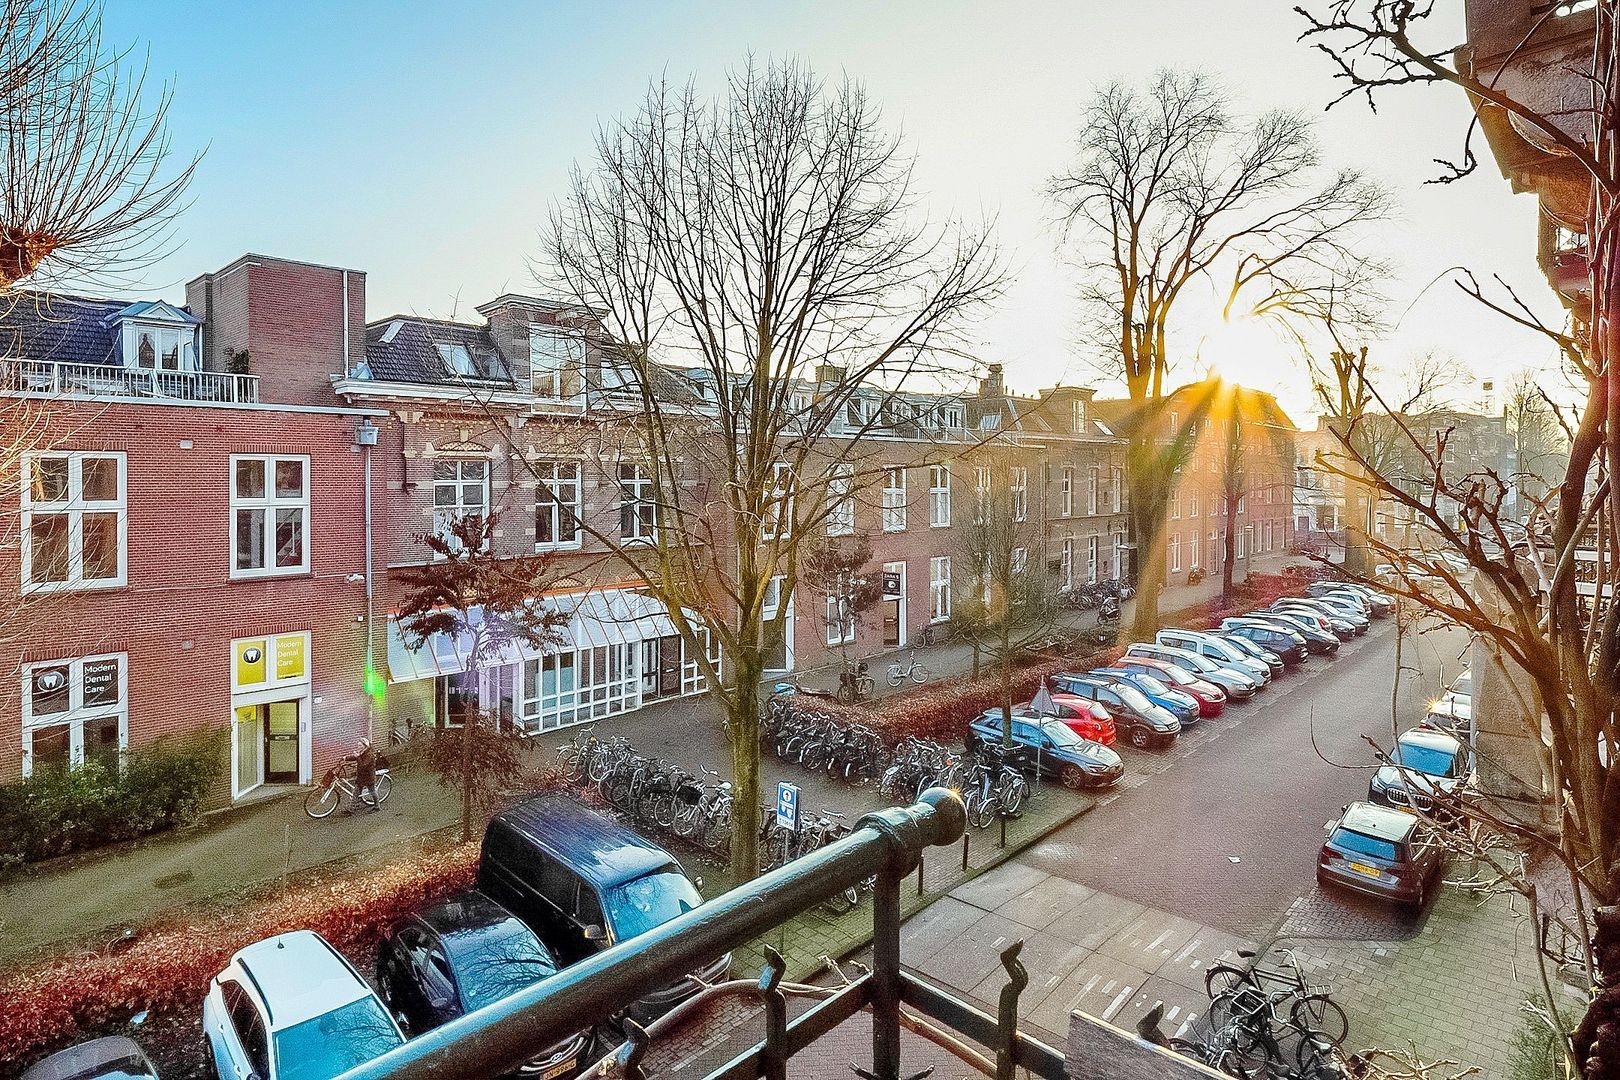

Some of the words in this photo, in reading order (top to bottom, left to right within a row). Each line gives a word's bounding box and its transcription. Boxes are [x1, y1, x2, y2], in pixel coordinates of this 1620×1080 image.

[277, 649, 299, 657] Dental
[277, 659, 293, 667] Care
[84, 663, 117, 674] Modern
[84, 673, 112, 684] Dental
[84, 685, 105, 694] Care
